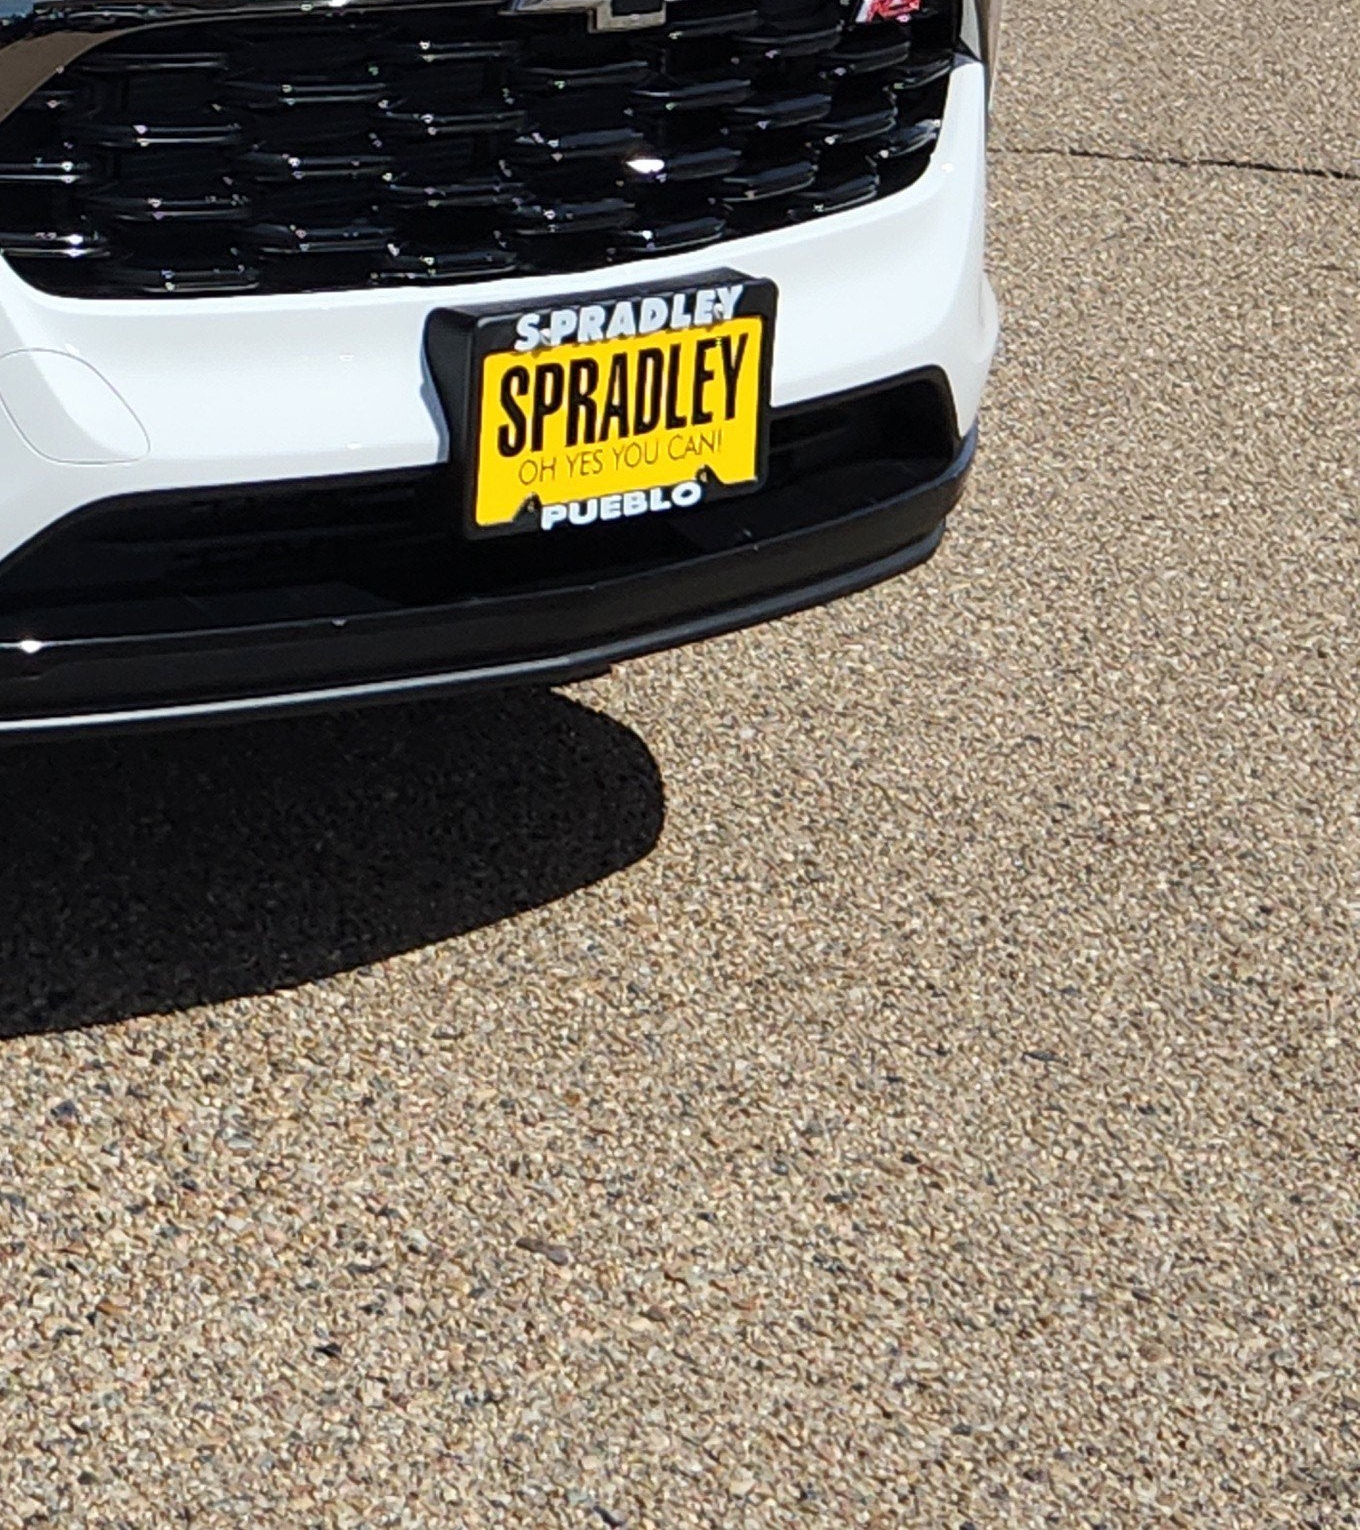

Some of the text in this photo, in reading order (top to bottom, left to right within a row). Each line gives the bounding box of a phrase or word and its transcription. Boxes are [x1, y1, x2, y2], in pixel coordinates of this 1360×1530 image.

[497, 332, 749, 458] SPRADLEY
[518, 429, 723, 486] OH YES YOU CAN!
[540, 481, 704, 530] PUEBLO
